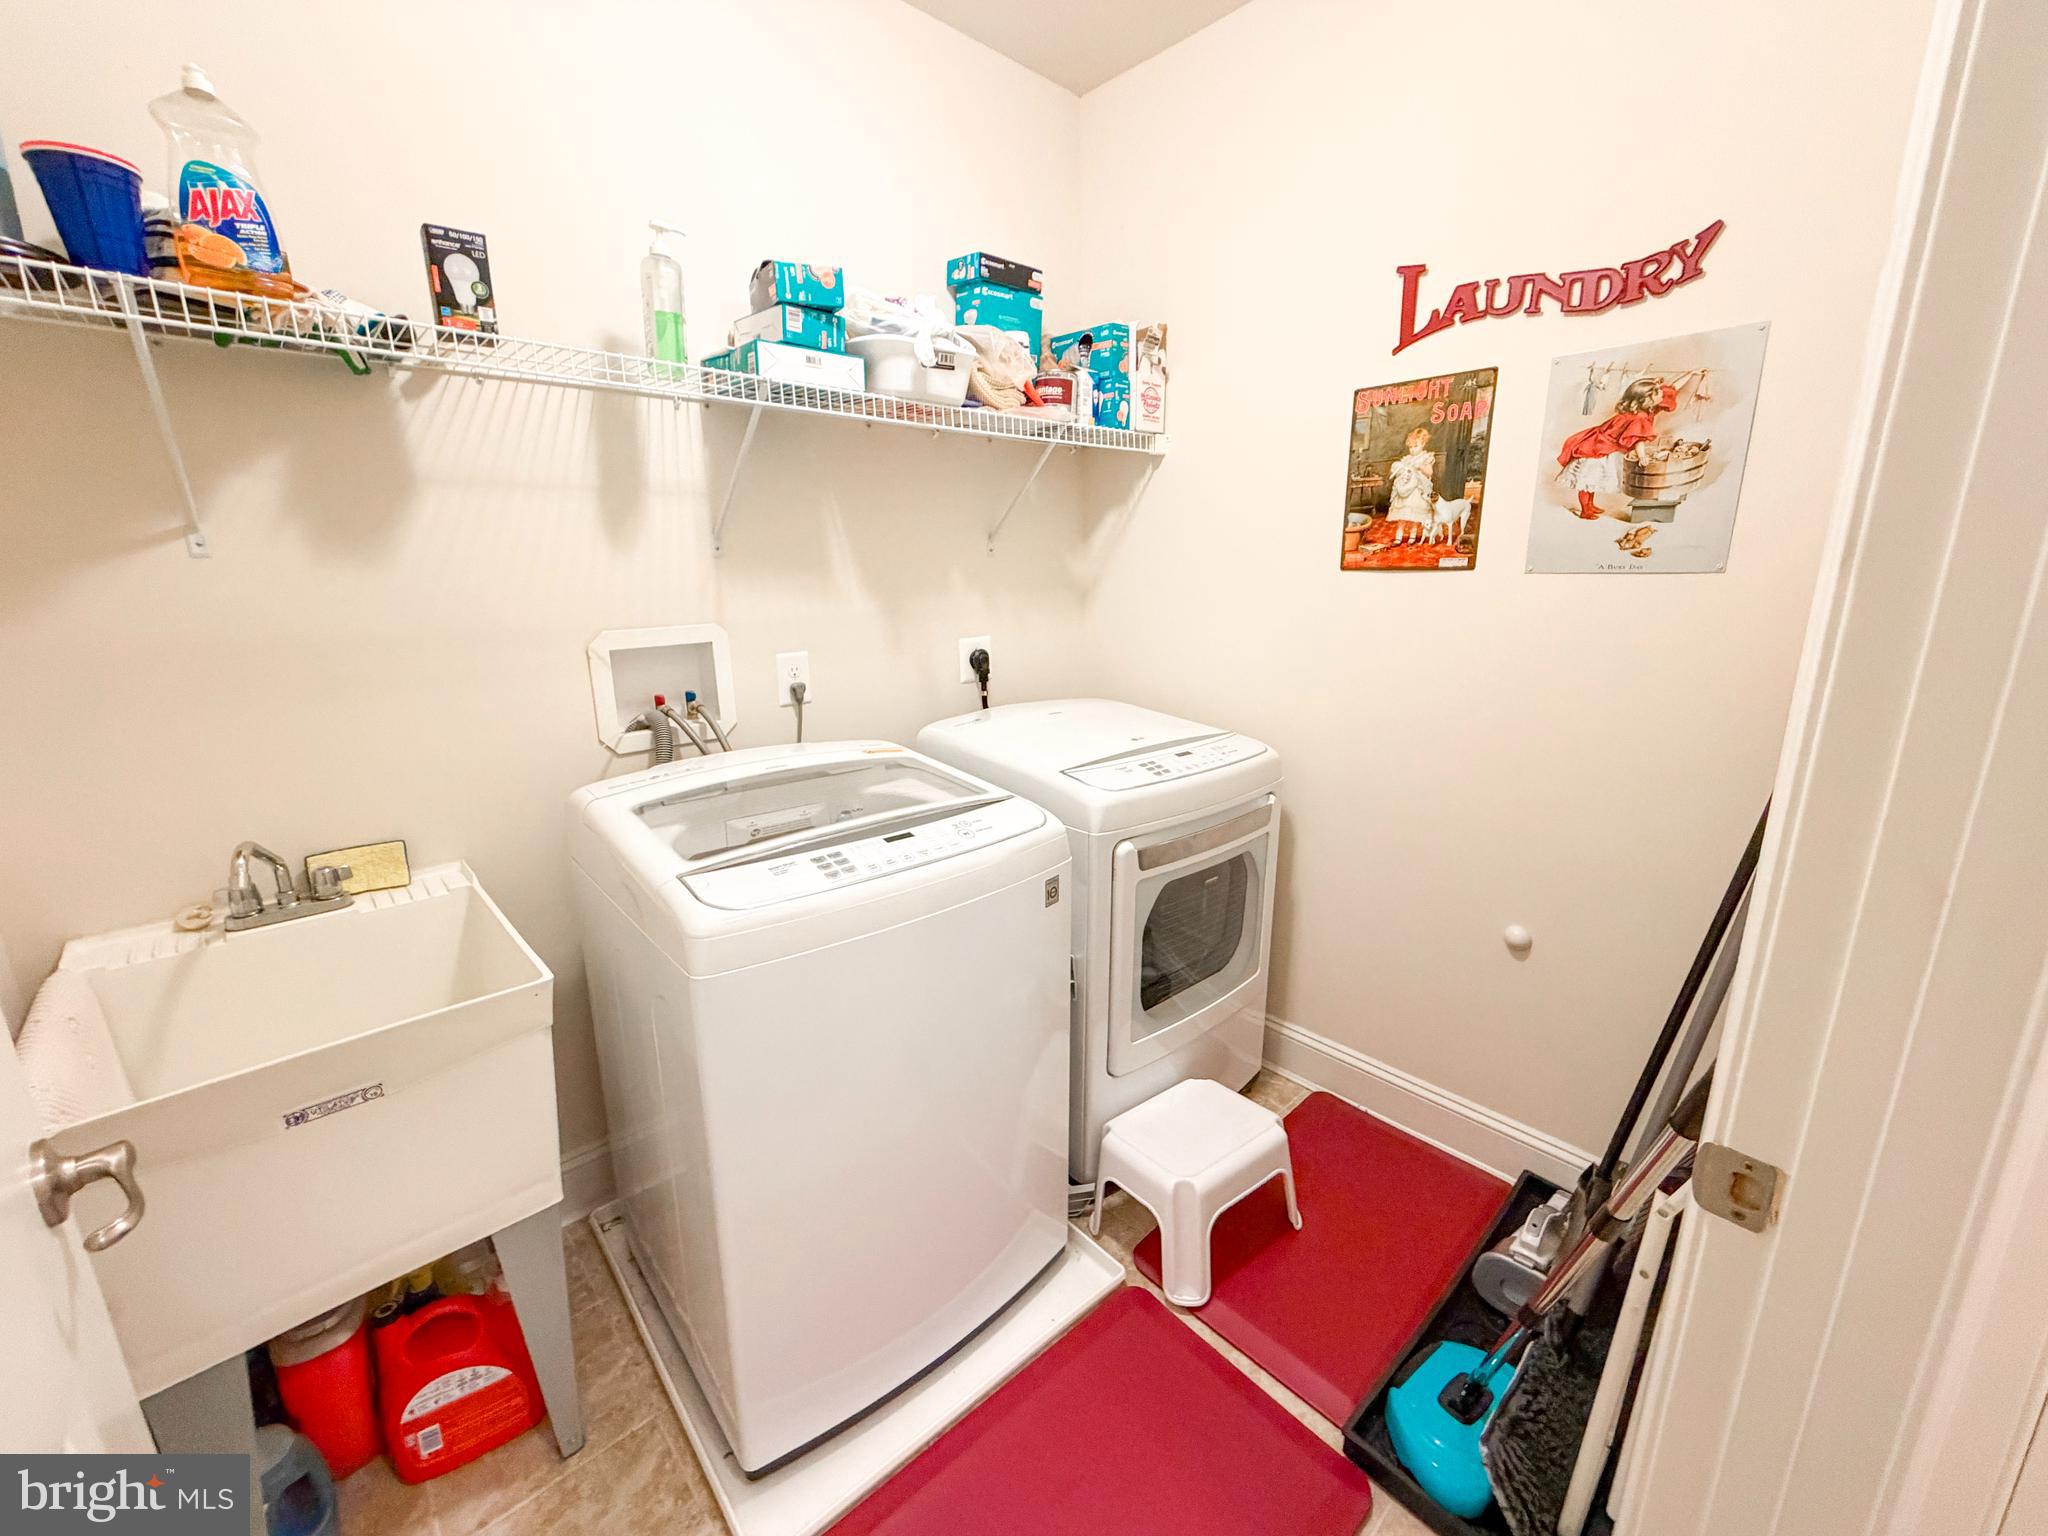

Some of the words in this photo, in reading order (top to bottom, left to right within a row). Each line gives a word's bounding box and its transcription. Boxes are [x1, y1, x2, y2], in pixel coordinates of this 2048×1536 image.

[187, 187, 262, 228] AJAX
[471, 250, 487, 259] LED
[1392, 219, 1724, 356] LAUNDRY
[1355, 376, 1455, 414] SUNLIGHT
[1430, 400, 1489, 425] SOAP
